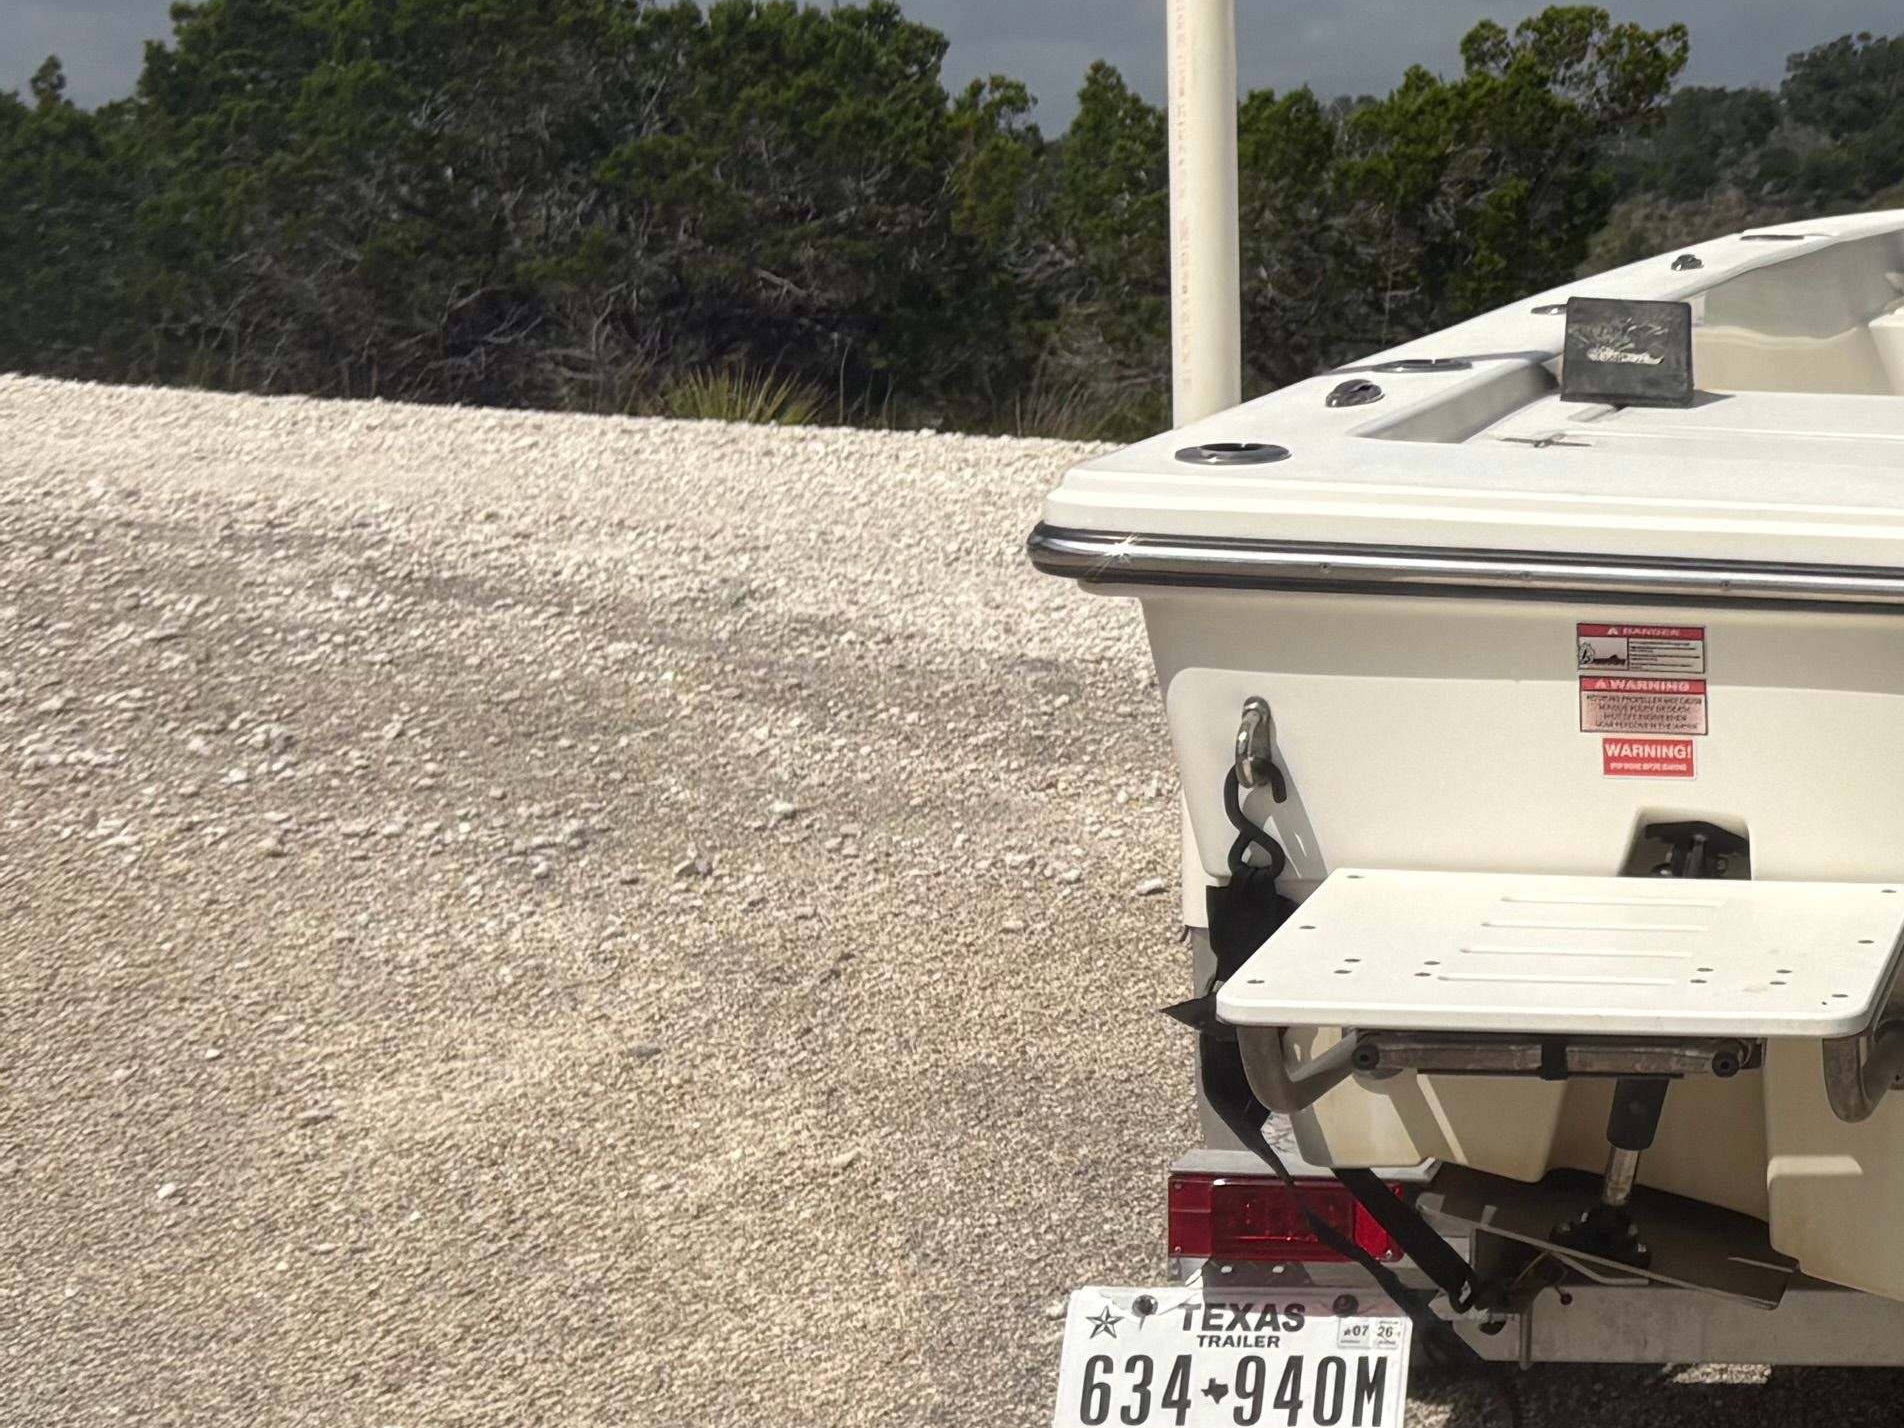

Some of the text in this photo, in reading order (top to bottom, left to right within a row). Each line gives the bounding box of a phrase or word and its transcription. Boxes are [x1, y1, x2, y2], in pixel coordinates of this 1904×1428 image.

[1610, 679, 1690, 692] WARNING
[1604, 743, 1692, 759] WARNING!
[1181, 1303, 1305, 1332] TEXAS
[1196, 1335, 1281, 1349] TRAILER
